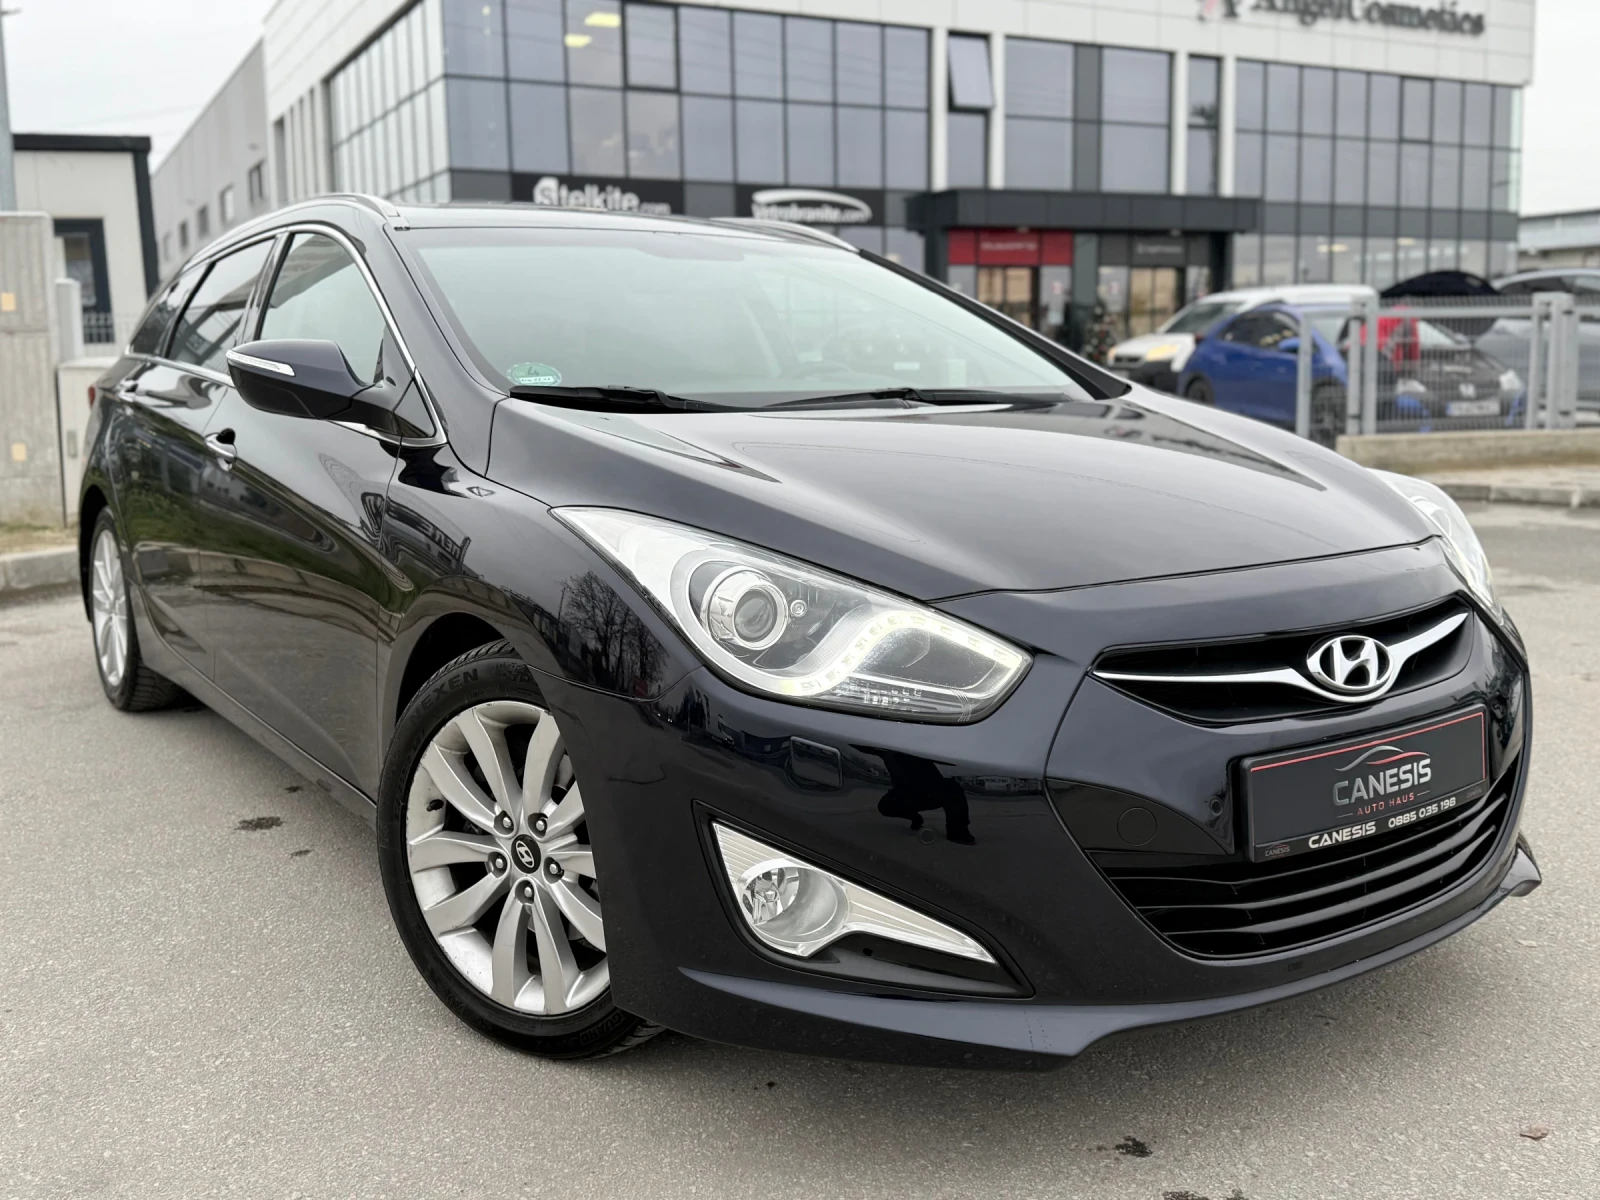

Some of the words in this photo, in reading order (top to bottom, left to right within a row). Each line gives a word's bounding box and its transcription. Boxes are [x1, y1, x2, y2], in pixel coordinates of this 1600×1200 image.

[410, 668, 479, 727] NEXEN
[1333, 758, 1432, 806] CANESIS
[1357, 801, 1385, 817] AUTO
[1389, 792, 1415, 807] HAUS
[1308, 821, 1377, 849] CANESIS
[1388, 810, 1417, 828] 0885
[1418, 803, 1439, 818] 035
[1440, 797, 1457, 811] 198
